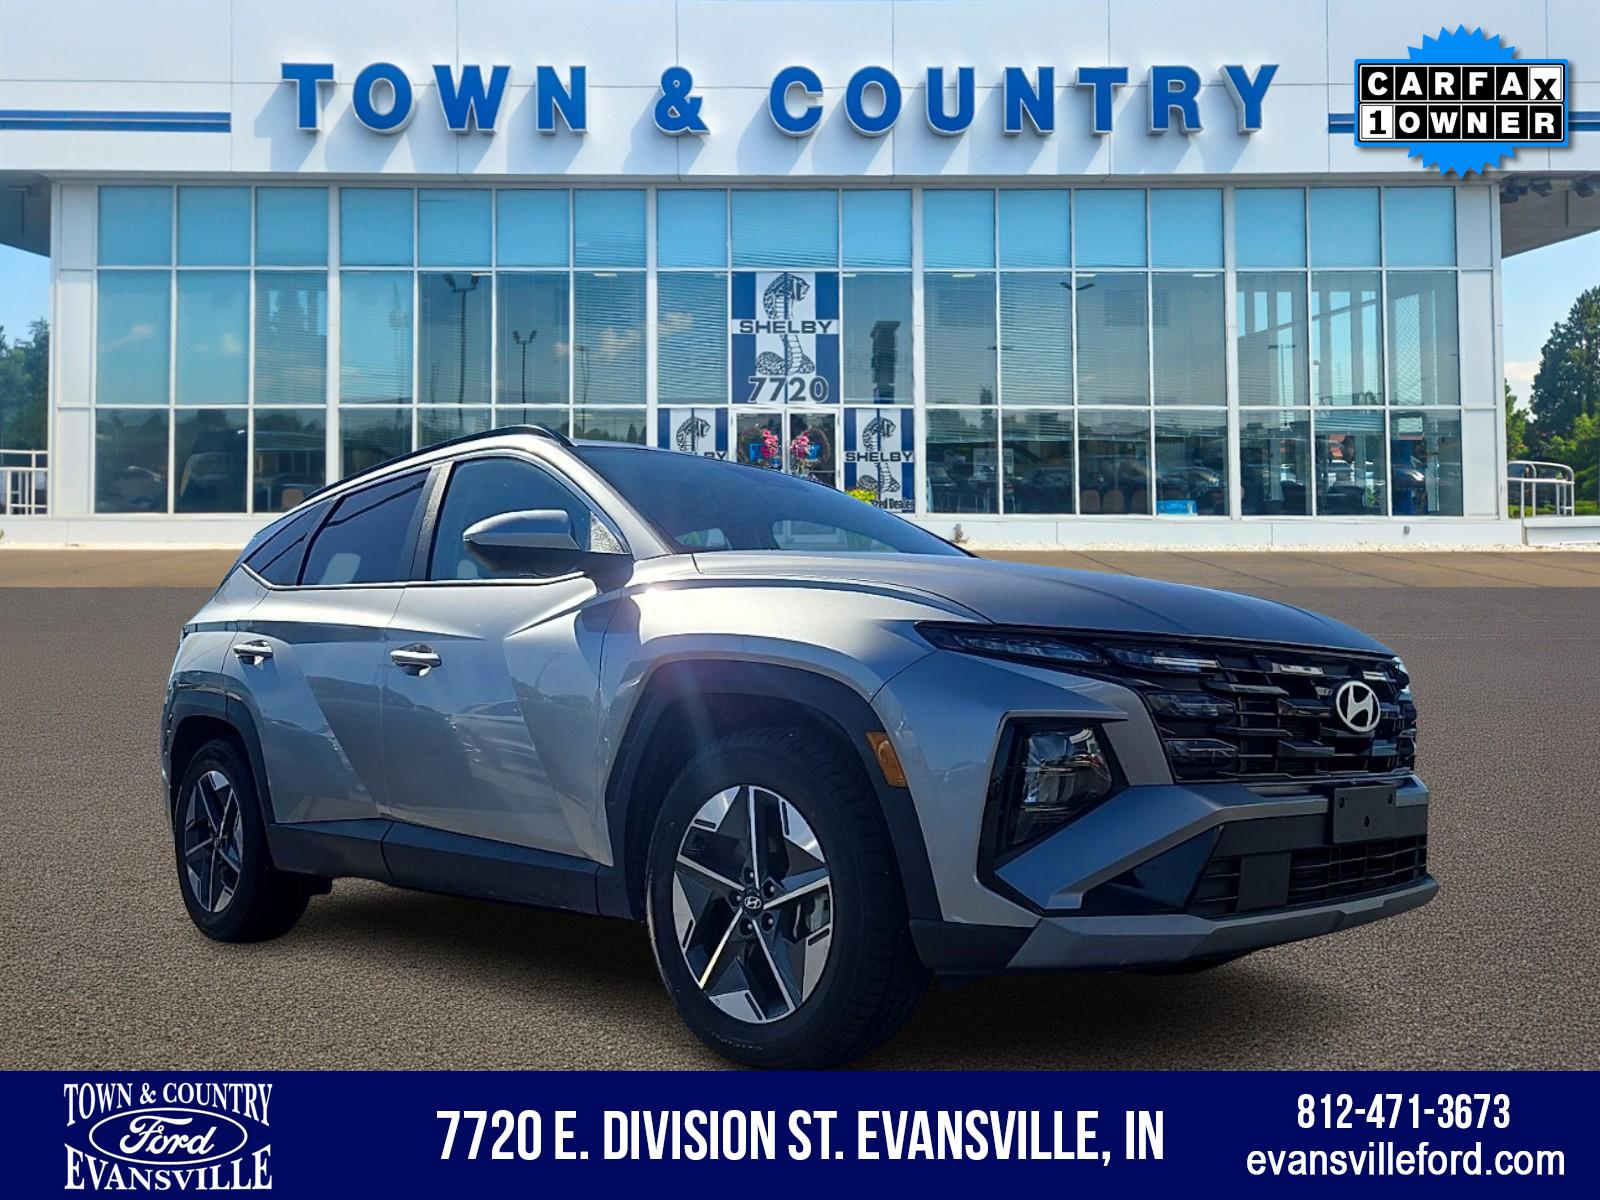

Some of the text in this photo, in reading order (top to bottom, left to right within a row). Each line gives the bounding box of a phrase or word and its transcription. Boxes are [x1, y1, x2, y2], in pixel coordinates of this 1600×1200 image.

[280, 62, 1280, 137] TOWN & COUNTRY
[739, 319, 832, 334] SHELBY
[748, 375, 829, 403] 7720
[845, 451, 913, 462] SHELBY
